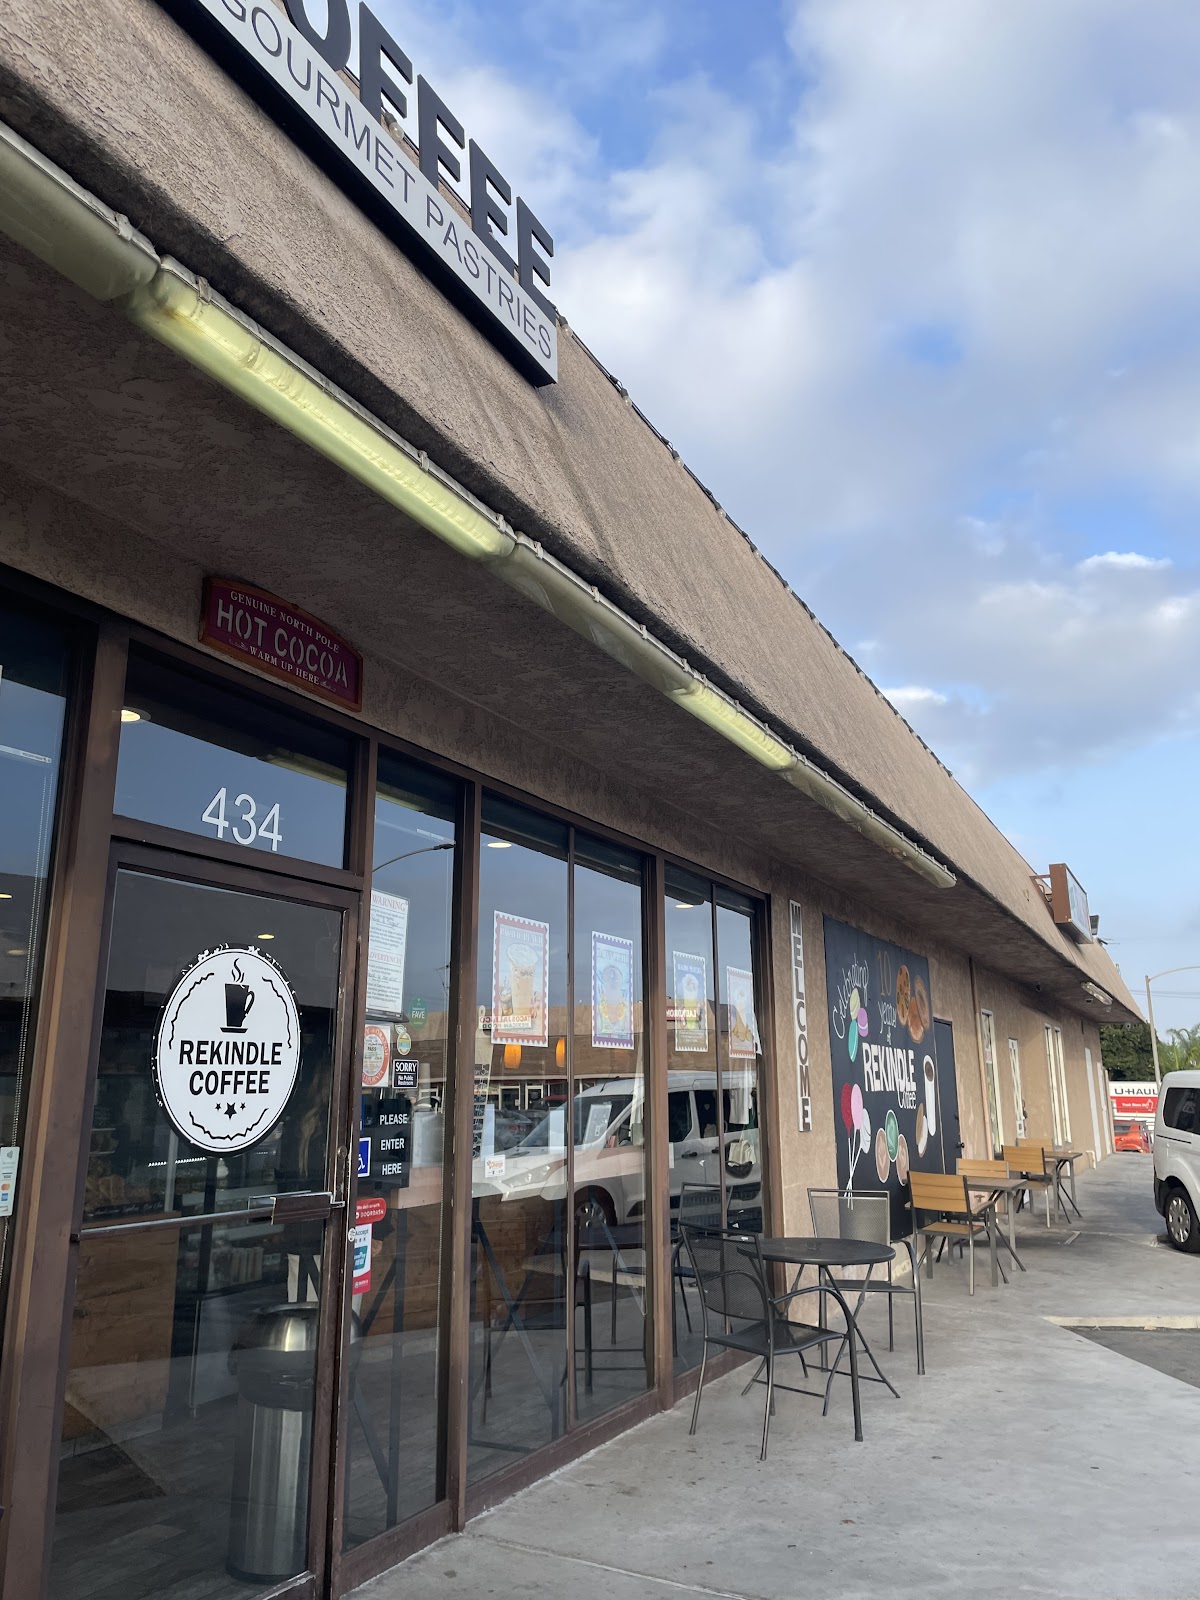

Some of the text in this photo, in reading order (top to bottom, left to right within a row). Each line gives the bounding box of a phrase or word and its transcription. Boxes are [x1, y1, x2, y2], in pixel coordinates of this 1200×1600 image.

[426, 194, 552, 360] PASTRIES
[230, 590, 339, 654] GENUINE NORTH POLE
[217, 598, 349, 688] HOT COCOA
[250, 645, 320, 685] WARM UP HERE
[201, 787, 283, 852] 434
[372, 893, 406, 912] WARNING
[877, 949, 892, 996] 10
[411, 1010, 425, 1019] FAVE
[791, 903, 810, 1131] WELCOME
[877, 1000, 897, 1034] years
[178, 1040, 283, 1065] REKINDLE
[395, 1062, 417, 1072] SORRY
[862, 1042, 917, 1092] REKINDLE
[189, 1070, 271, 1096] COFFEE
[379, 1114, 408, 1125] PLEASE
[380, 1138, 405, 1151] ENTER
[381, 1163, 402, 1175] HERE
[360, 1209, 384, 1218] DOORDASH
